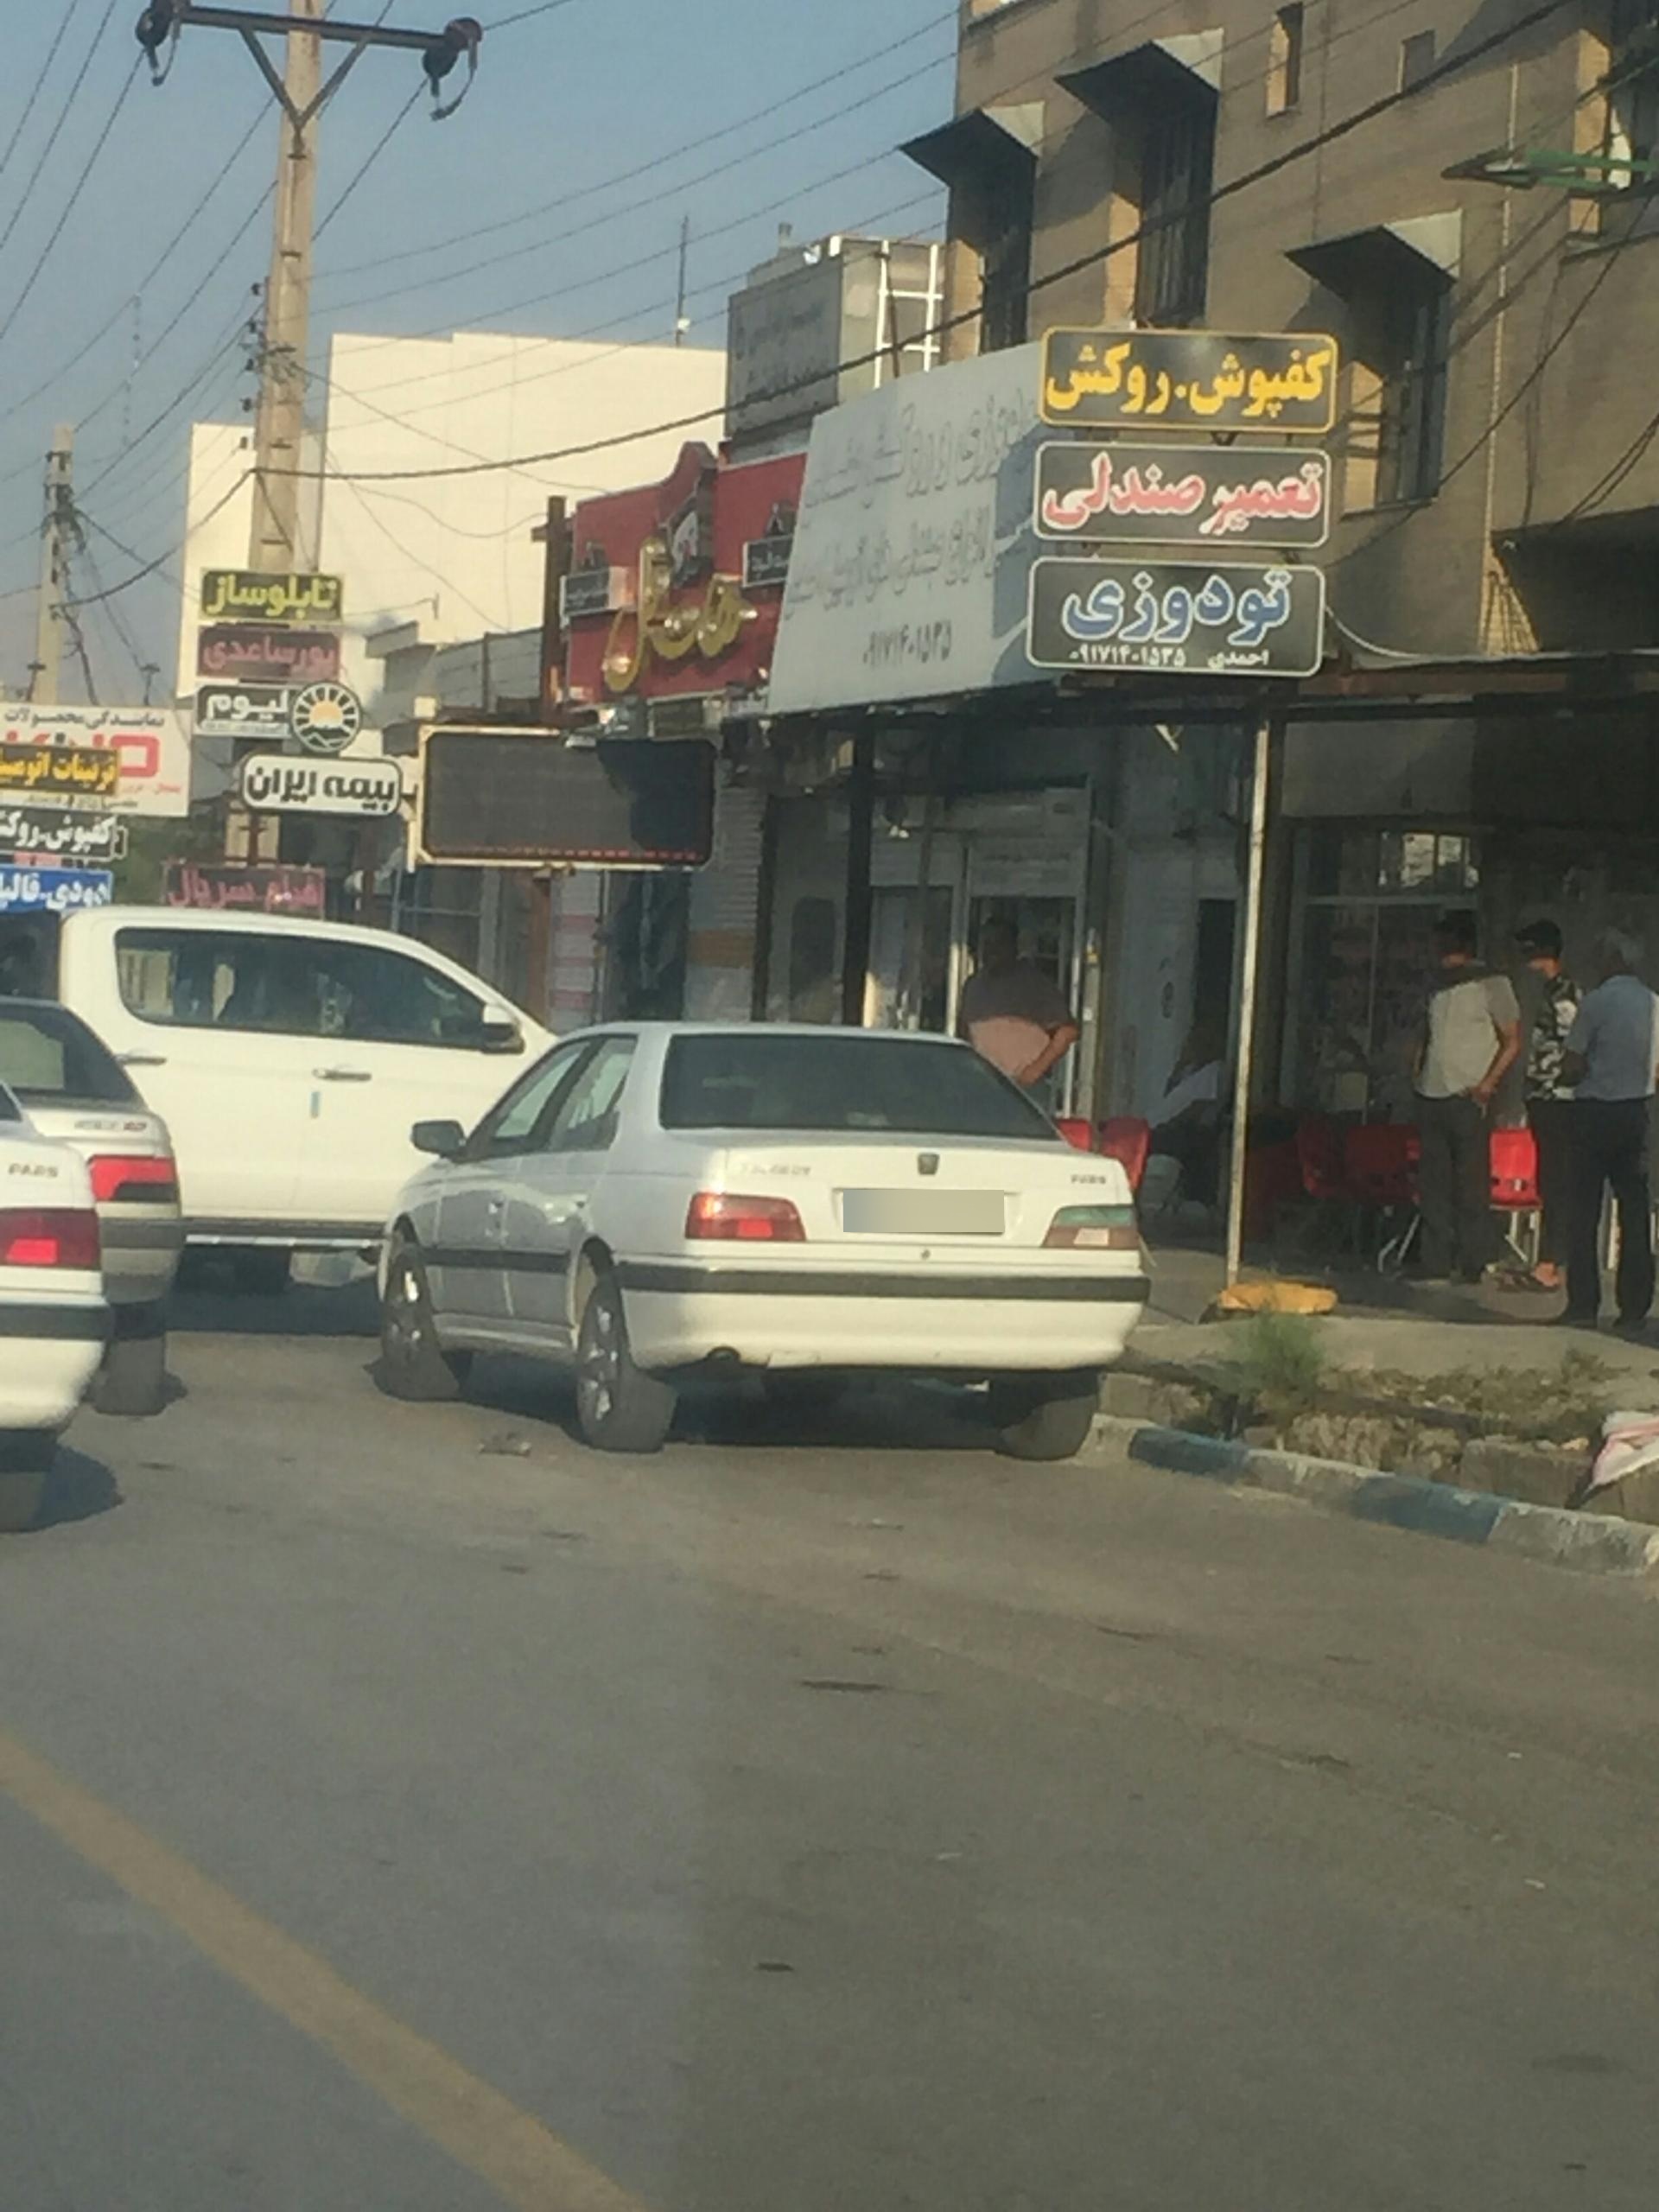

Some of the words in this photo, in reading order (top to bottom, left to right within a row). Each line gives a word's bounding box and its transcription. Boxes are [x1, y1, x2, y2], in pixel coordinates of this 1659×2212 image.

[1042, 451, 1206, 530] صندلی
[1199, 461, 1324, 535] تعمیر
[1061, 569, 1293, 645] تودوزی
[1069, 643, 1187, 668] ۰۹۱۷۱۴۰۱۵۳۵
[1207, 650, 1270, 670] احمدی
[247, 766, 317, 803] ایران
[322, 776, 395, 811] بیمه
[0, 810, 39, 847] روک
[8, 1163, 59, 1178] PARS
